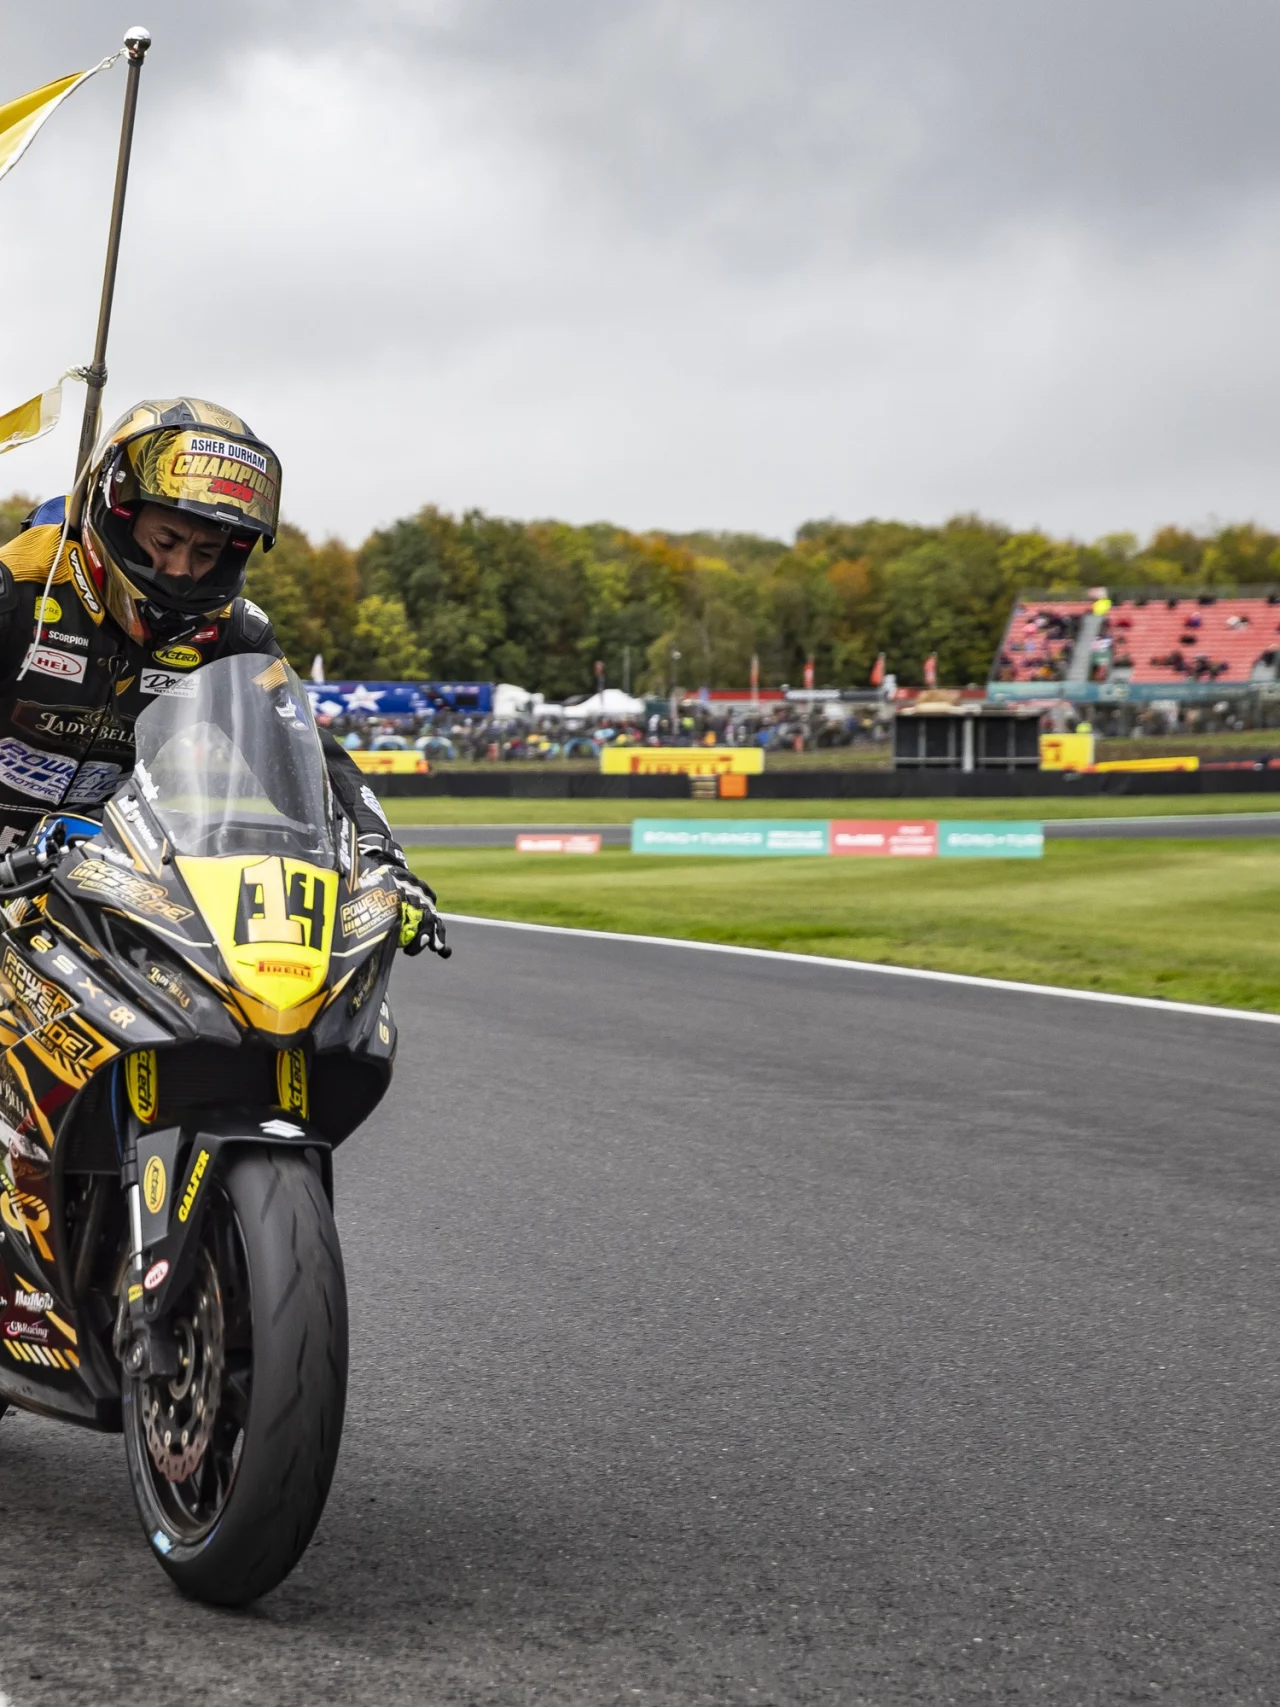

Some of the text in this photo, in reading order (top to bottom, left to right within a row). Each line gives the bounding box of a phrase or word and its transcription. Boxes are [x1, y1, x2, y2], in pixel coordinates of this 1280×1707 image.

[191, 439, 265, 470] ASHER DURHAM
[173, 455, 274, 500] CHAMPION
[48, 630, 89, 647] SCORPION
[37, 657, 71, 673] HEL
[35, 712, 90, 736] LADY
[93, 725, 136, 743] BELL
[0, 743, 111, 779] POWER
[83, 860, 164, 897] POWER
[343, 890, 384, 922] POWER
[6, 953, 70, 1011] POWER
[259, 961, 312, 978] PIRELLI
[150, 966, 191, 1008] LADY BELLA
[178, 1150, 210, 1222] GALFER
[149, 1270, 165, 1286] HEL
